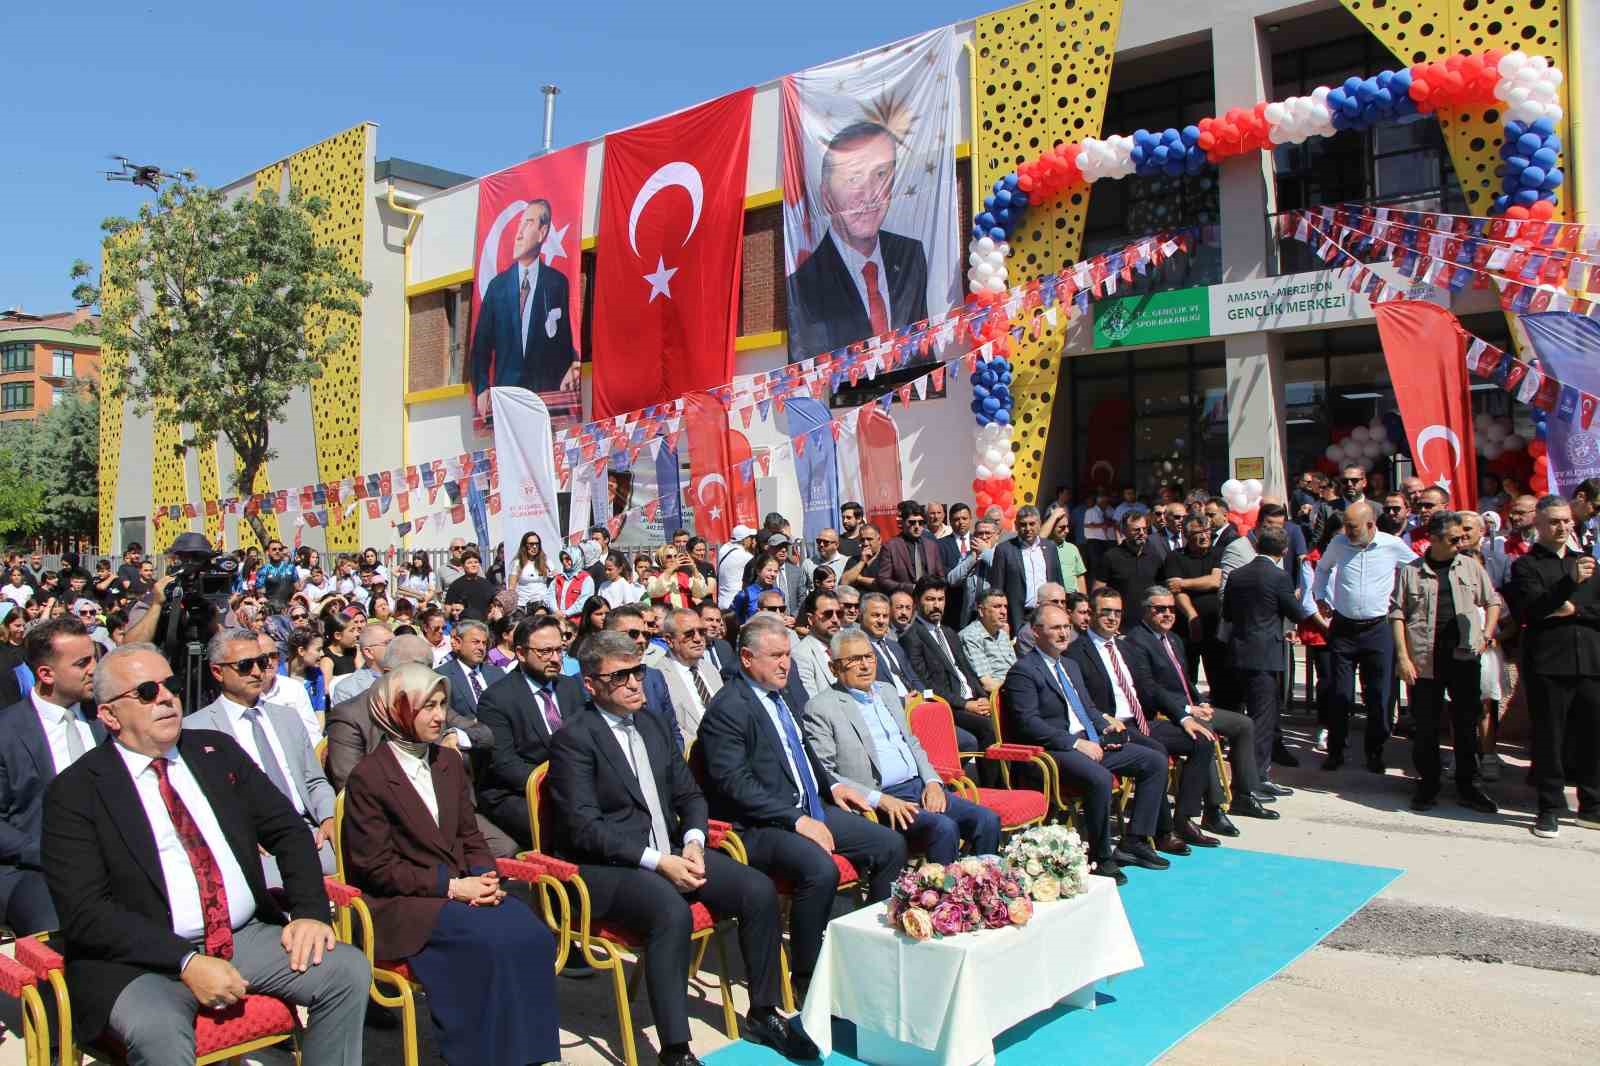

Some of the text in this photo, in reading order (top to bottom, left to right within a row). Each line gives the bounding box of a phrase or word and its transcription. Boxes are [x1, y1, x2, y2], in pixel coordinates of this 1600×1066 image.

[1227, 289, 1269, 303] AMASYA
[1277, 281, 1333, 297] MERZİFON
[1227, 293, 1346, 320] GENÇLİK MERKEZİ
